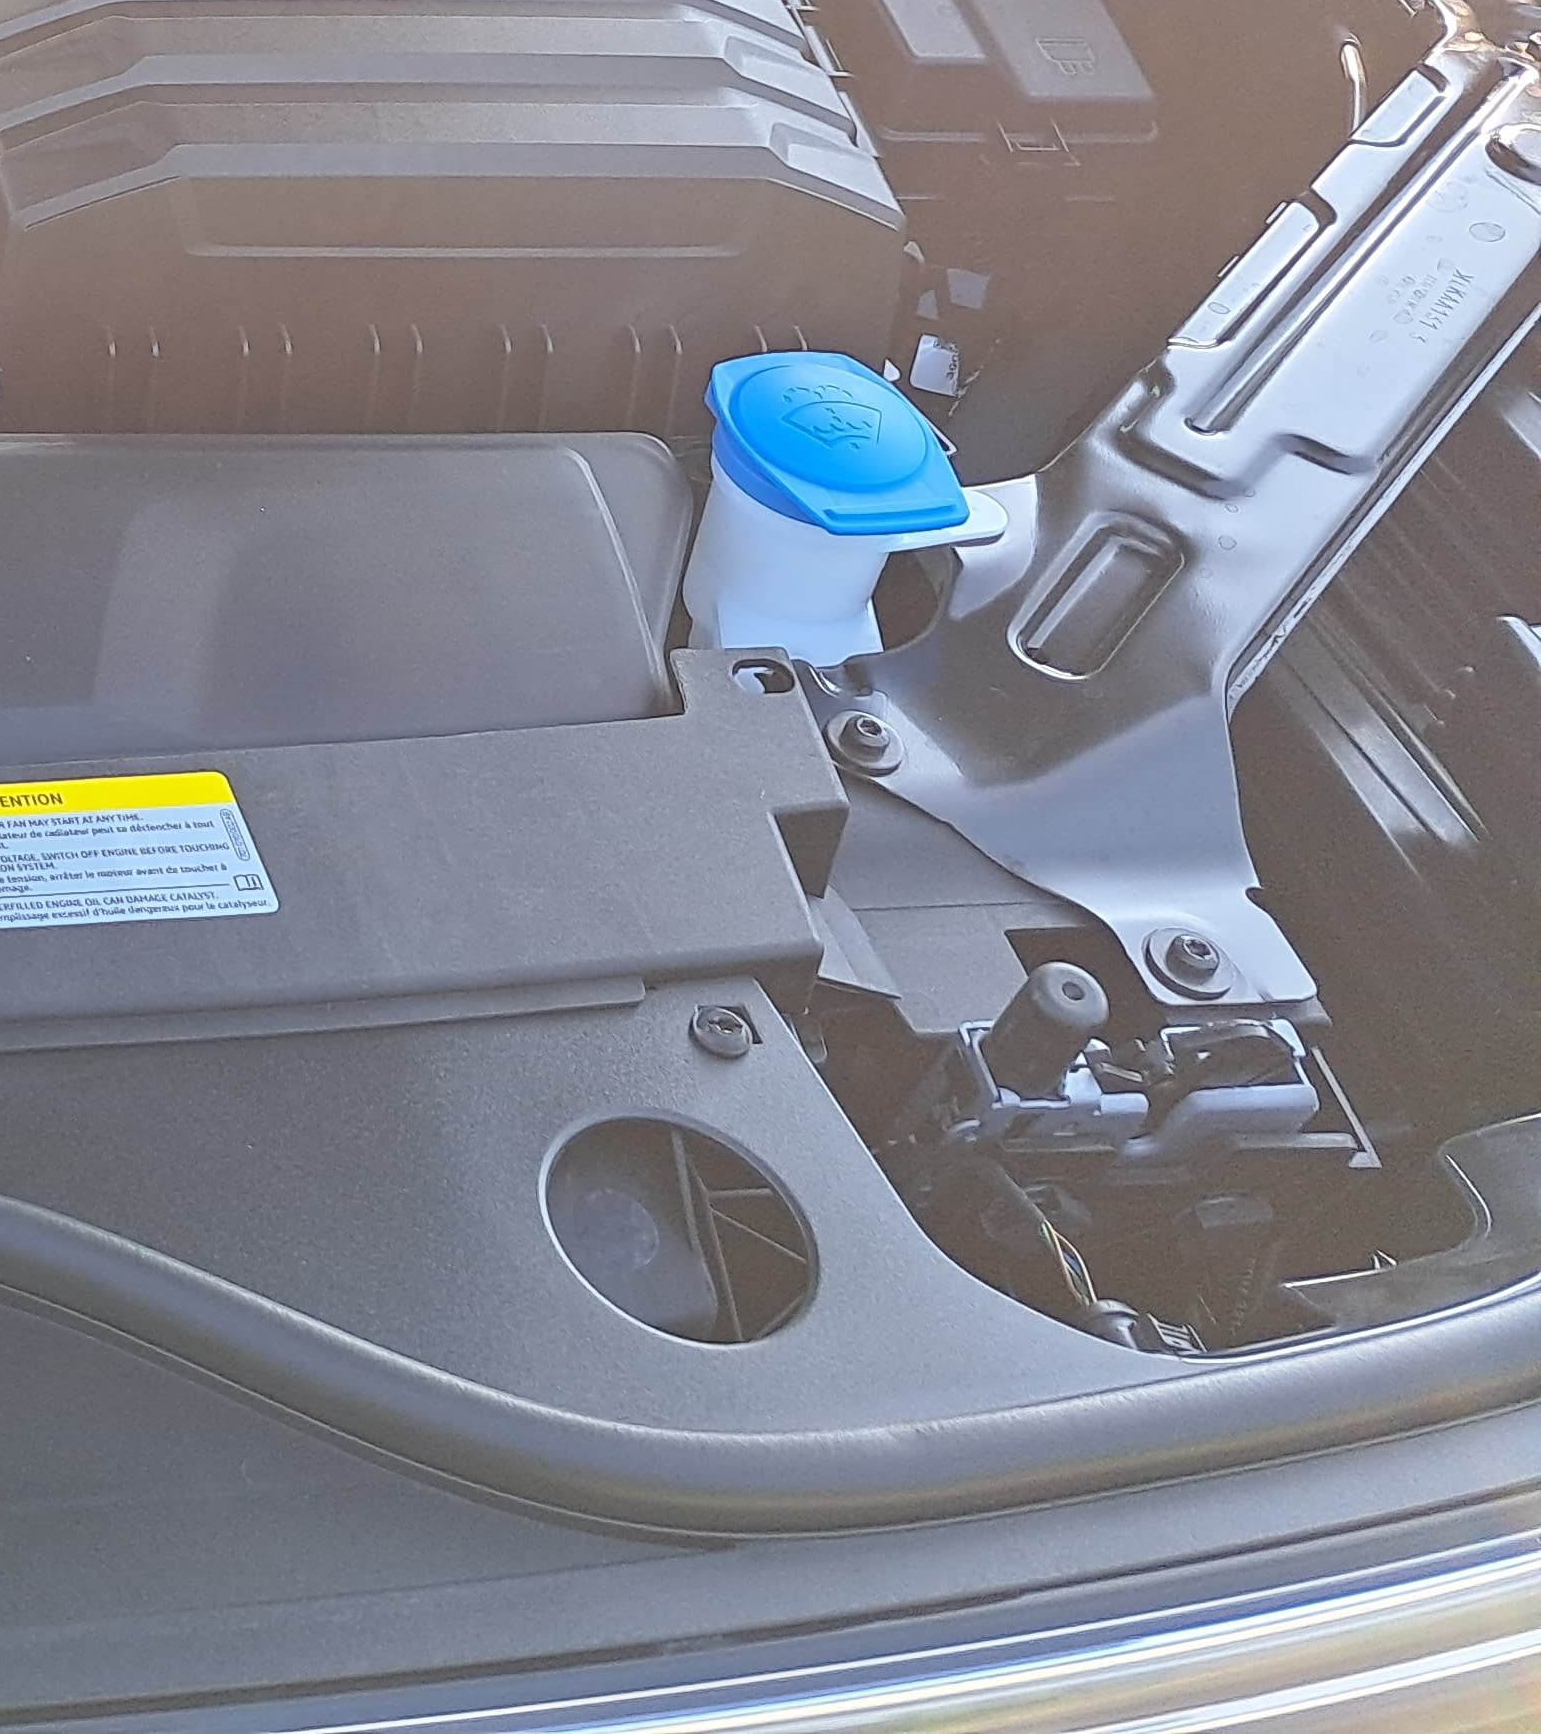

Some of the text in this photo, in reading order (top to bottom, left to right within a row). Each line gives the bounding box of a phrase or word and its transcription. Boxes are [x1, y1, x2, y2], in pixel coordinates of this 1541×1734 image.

[7, 820, 26, 828] FAN
[29, 819, 49, 827] MAY
[96, 814, 114, 822] ANY
[179, 842, 229, 853] TOUCHING
[136, 867, 163, 876] avant
[103, 896, 124, 905] CAN
[182, 903, 203, 912] pour
